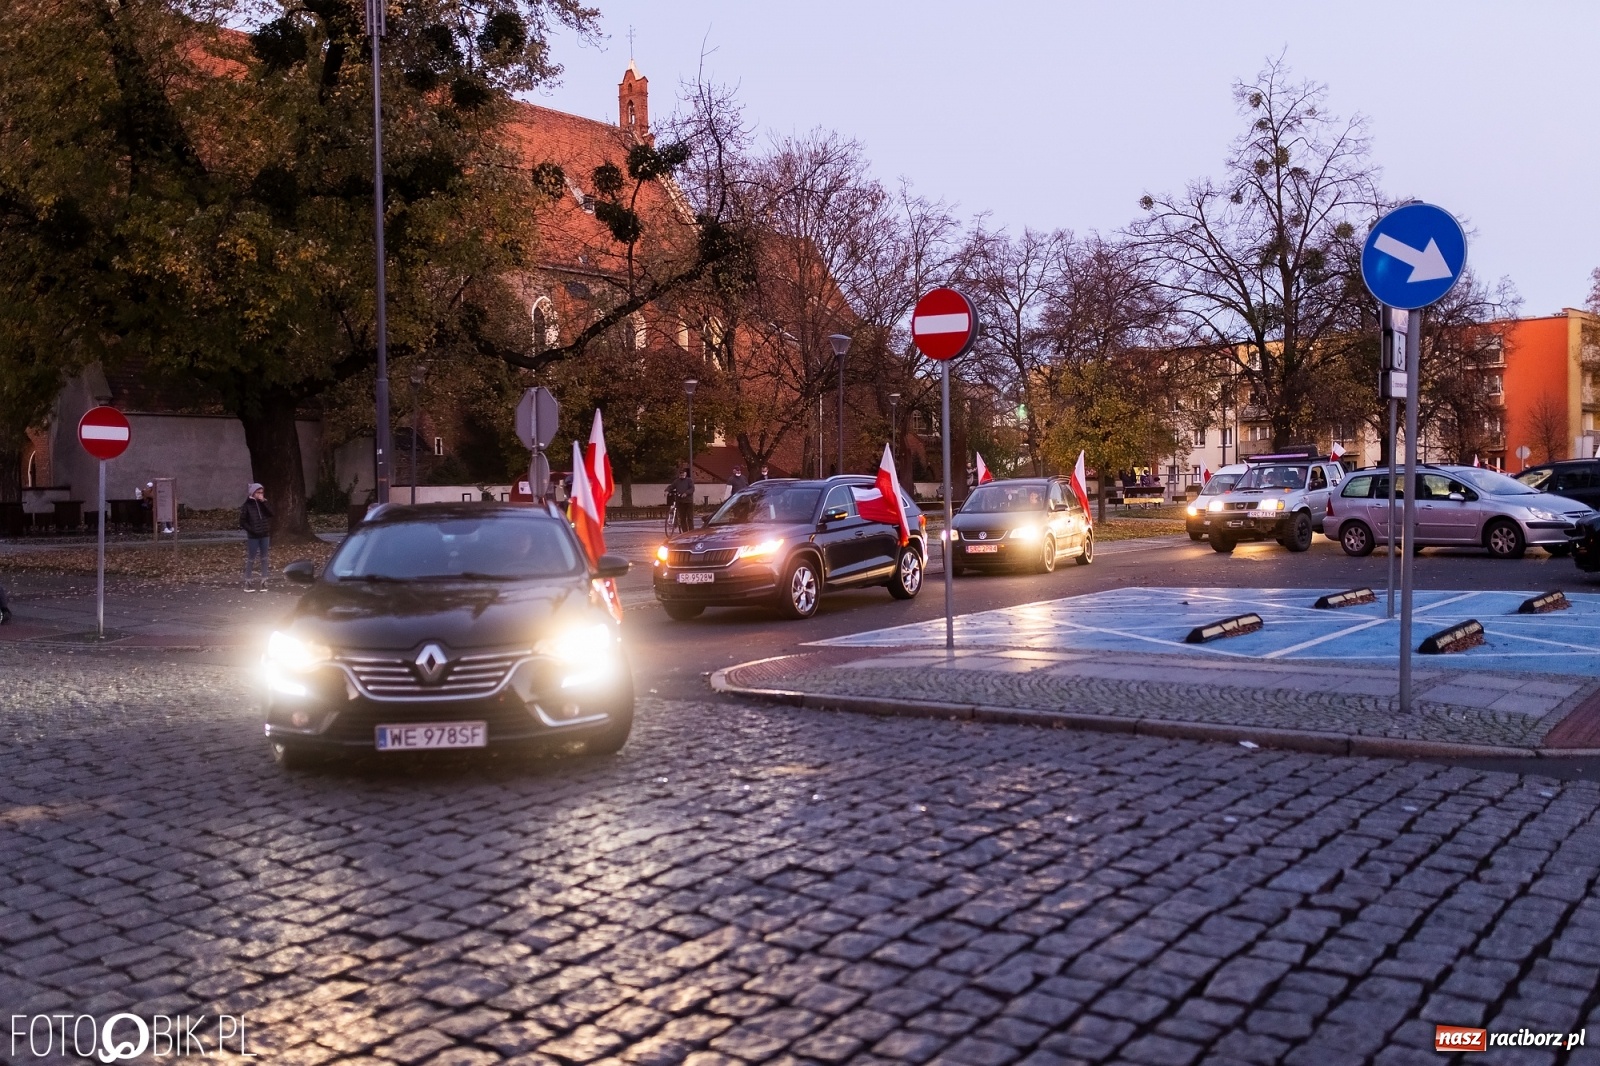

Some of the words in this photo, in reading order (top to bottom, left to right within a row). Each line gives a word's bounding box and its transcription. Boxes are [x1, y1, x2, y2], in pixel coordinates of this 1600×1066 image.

[680, 573, 690, 582] SR
[389, 728, 417, 747] WE
[423, 726, 480, 746] 978SF
